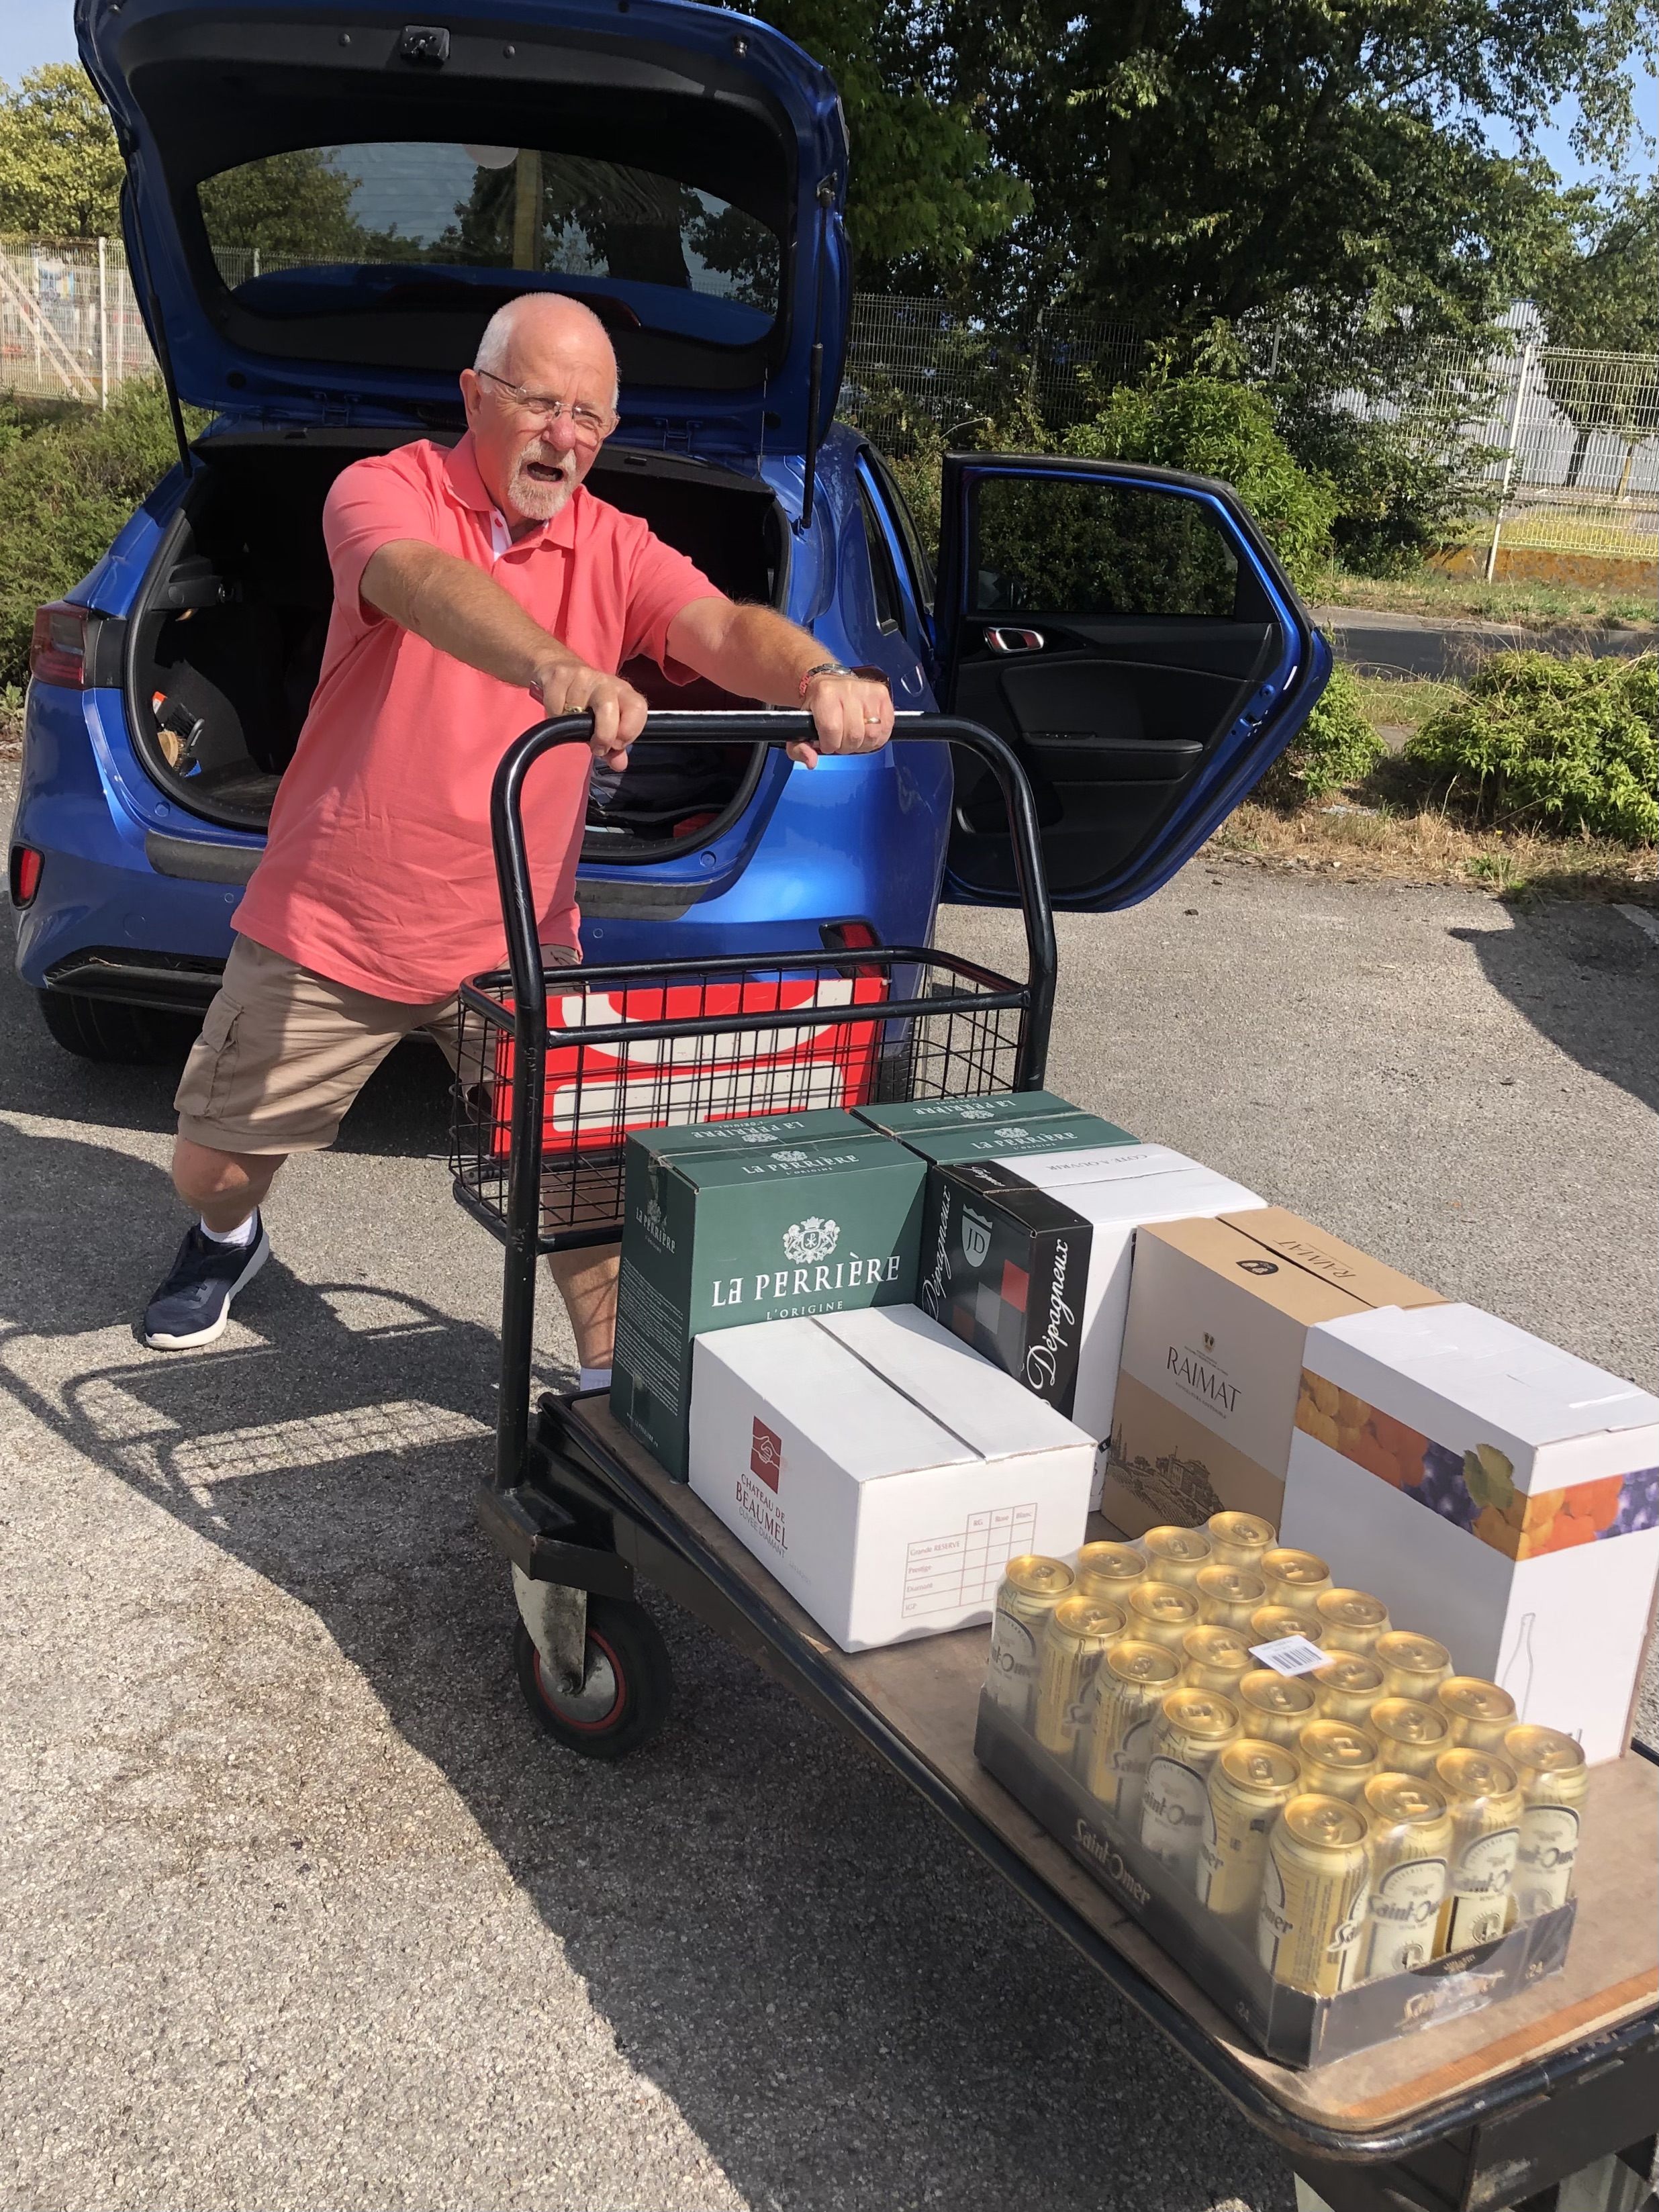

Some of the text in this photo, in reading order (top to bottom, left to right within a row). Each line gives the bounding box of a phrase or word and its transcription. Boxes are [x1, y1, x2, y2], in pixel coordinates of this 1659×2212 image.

[992, 1131, 1078, 1147] PERRIÈRE
[766, 1154, 860, 1172] PERRIÈRE
[712, 1251, 901, 1308] La PERRIÈRE
[1272, 1239, 1356, 1278] RAIMAT
[766, 1300, 844, 1320] L'ORIGINE
[1026, 1238, 1076, 1390] Dépagneux
[1167, 1346, 1242, 1412] RAIMAT
[736, 1481, 788, 1550] BEAUMEL
[741, 1474, 786, 1524] CHATEAU DE
[759, 1527, 786, 1558] DIAMANT
